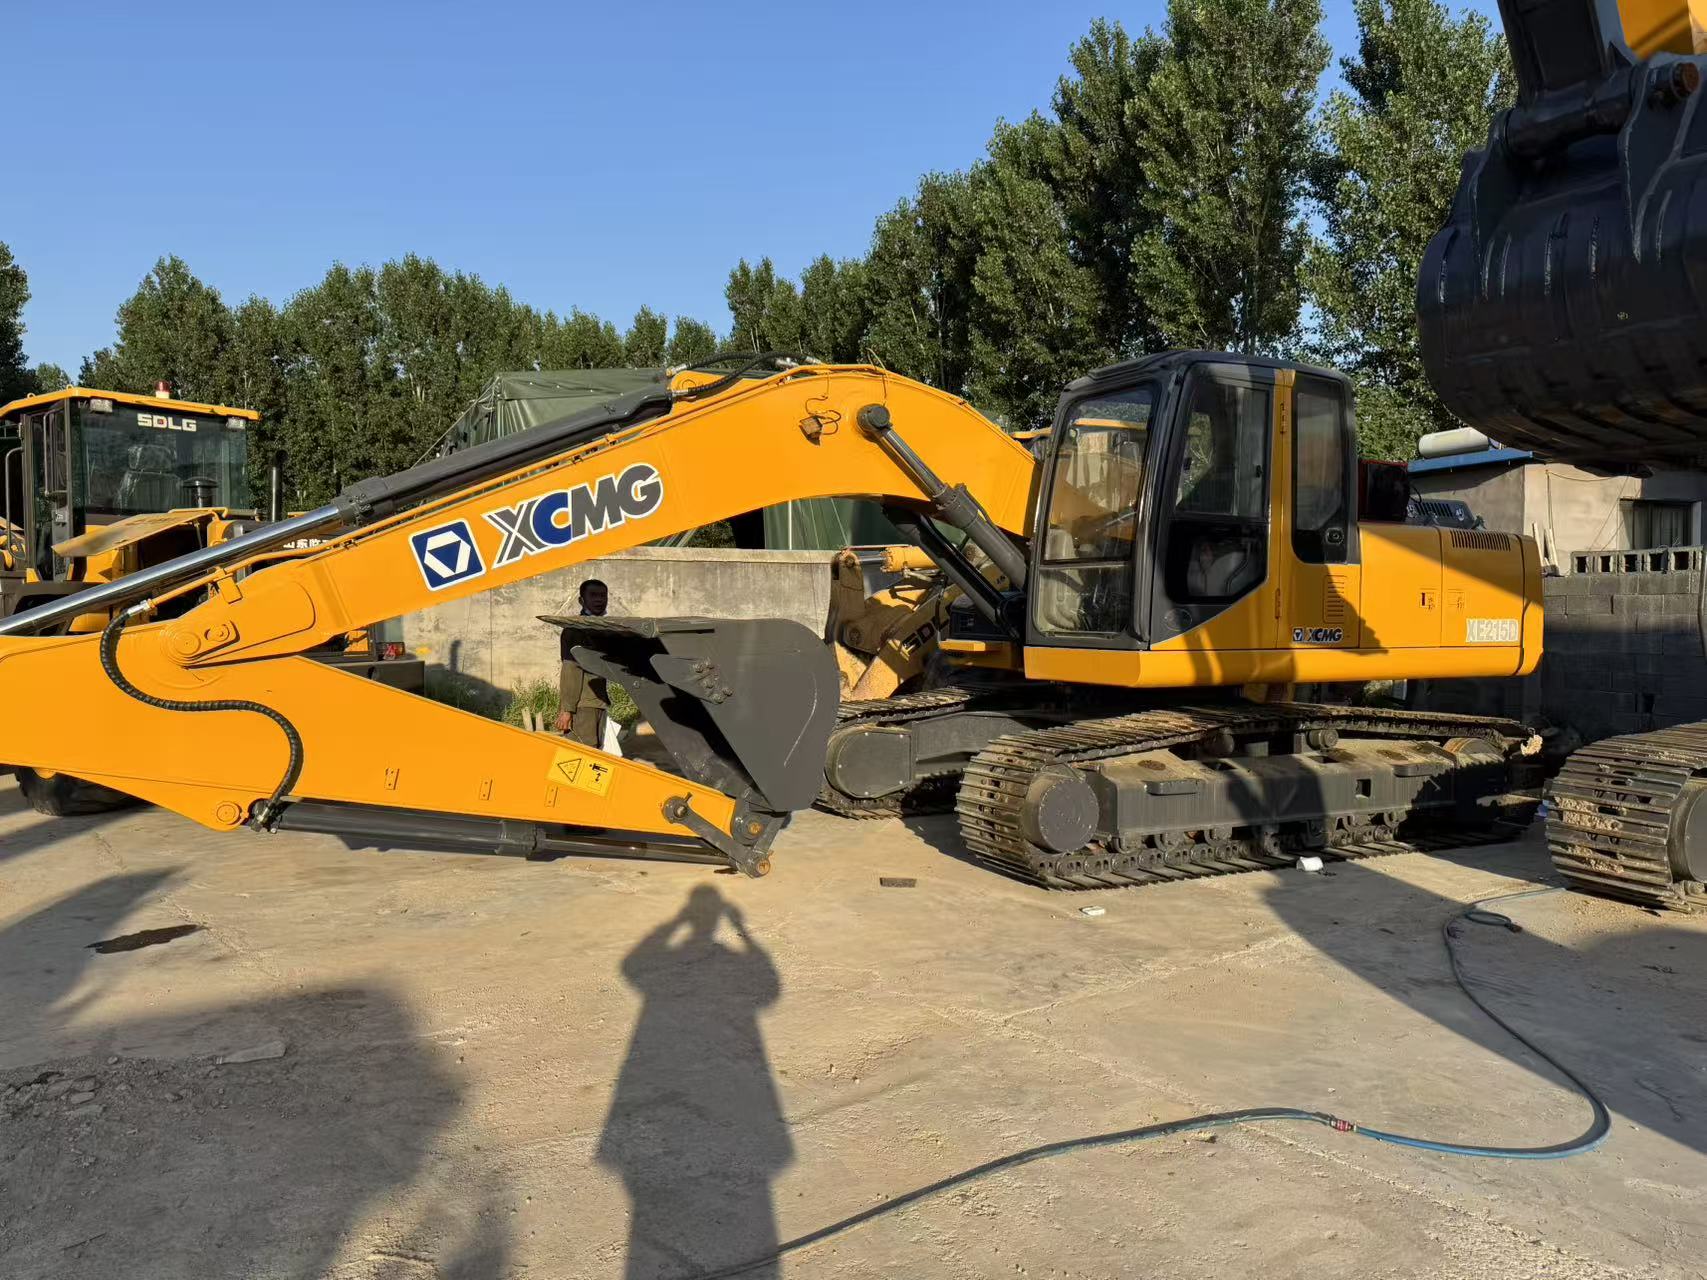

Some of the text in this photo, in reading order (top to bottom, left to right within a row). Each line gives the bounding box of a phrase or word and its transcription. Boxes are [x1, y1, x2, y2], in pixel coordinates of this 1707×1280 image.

[137, 413, 197, 432] SDLG
[483, 463, 663, 568] XCMG
[1305, 627, 1343, 643] XCMG
[1466, 618, 1518, 642] XE215D
